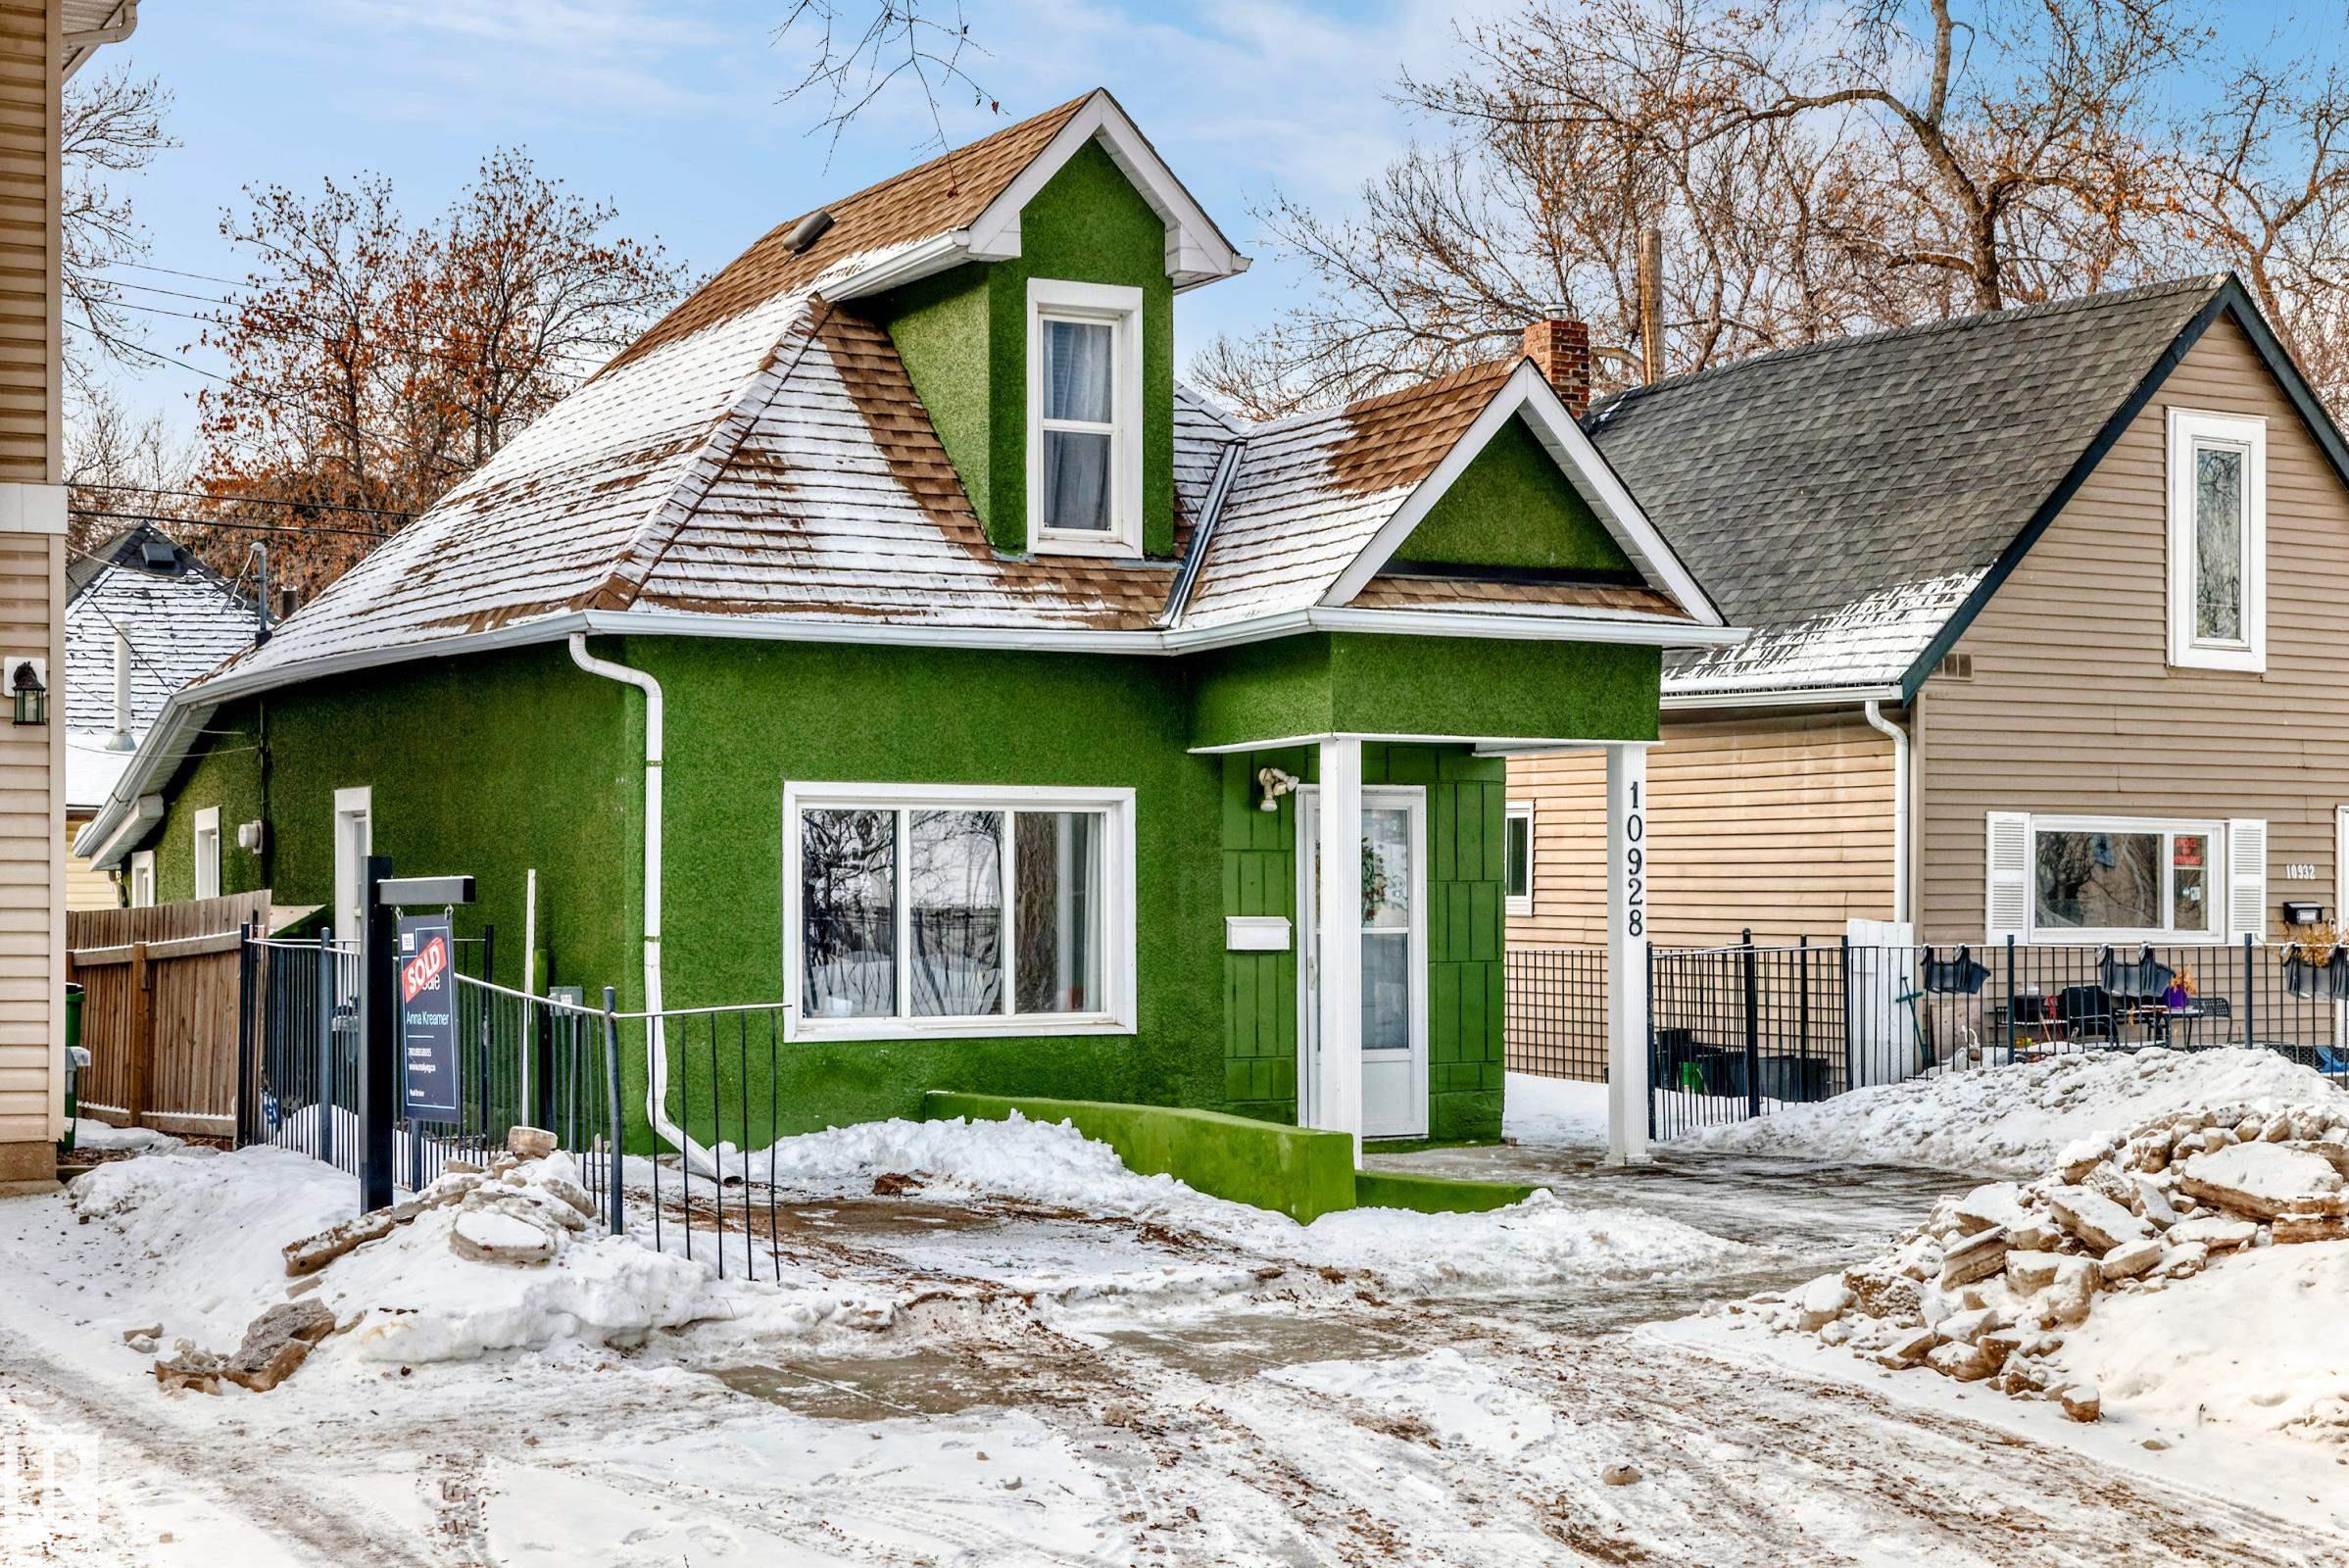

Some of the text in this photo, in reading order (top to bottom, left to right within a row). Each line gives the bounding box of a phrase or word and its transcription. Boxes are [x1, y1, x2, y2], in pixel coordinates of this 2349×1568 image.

[1627, 781, 1643, 937] 10928
[2286, 863, 2316, 880] 10932
[407, 944, 441, 994] SOLD
[406, 1010, 450, 1026] Anna Kreamer
